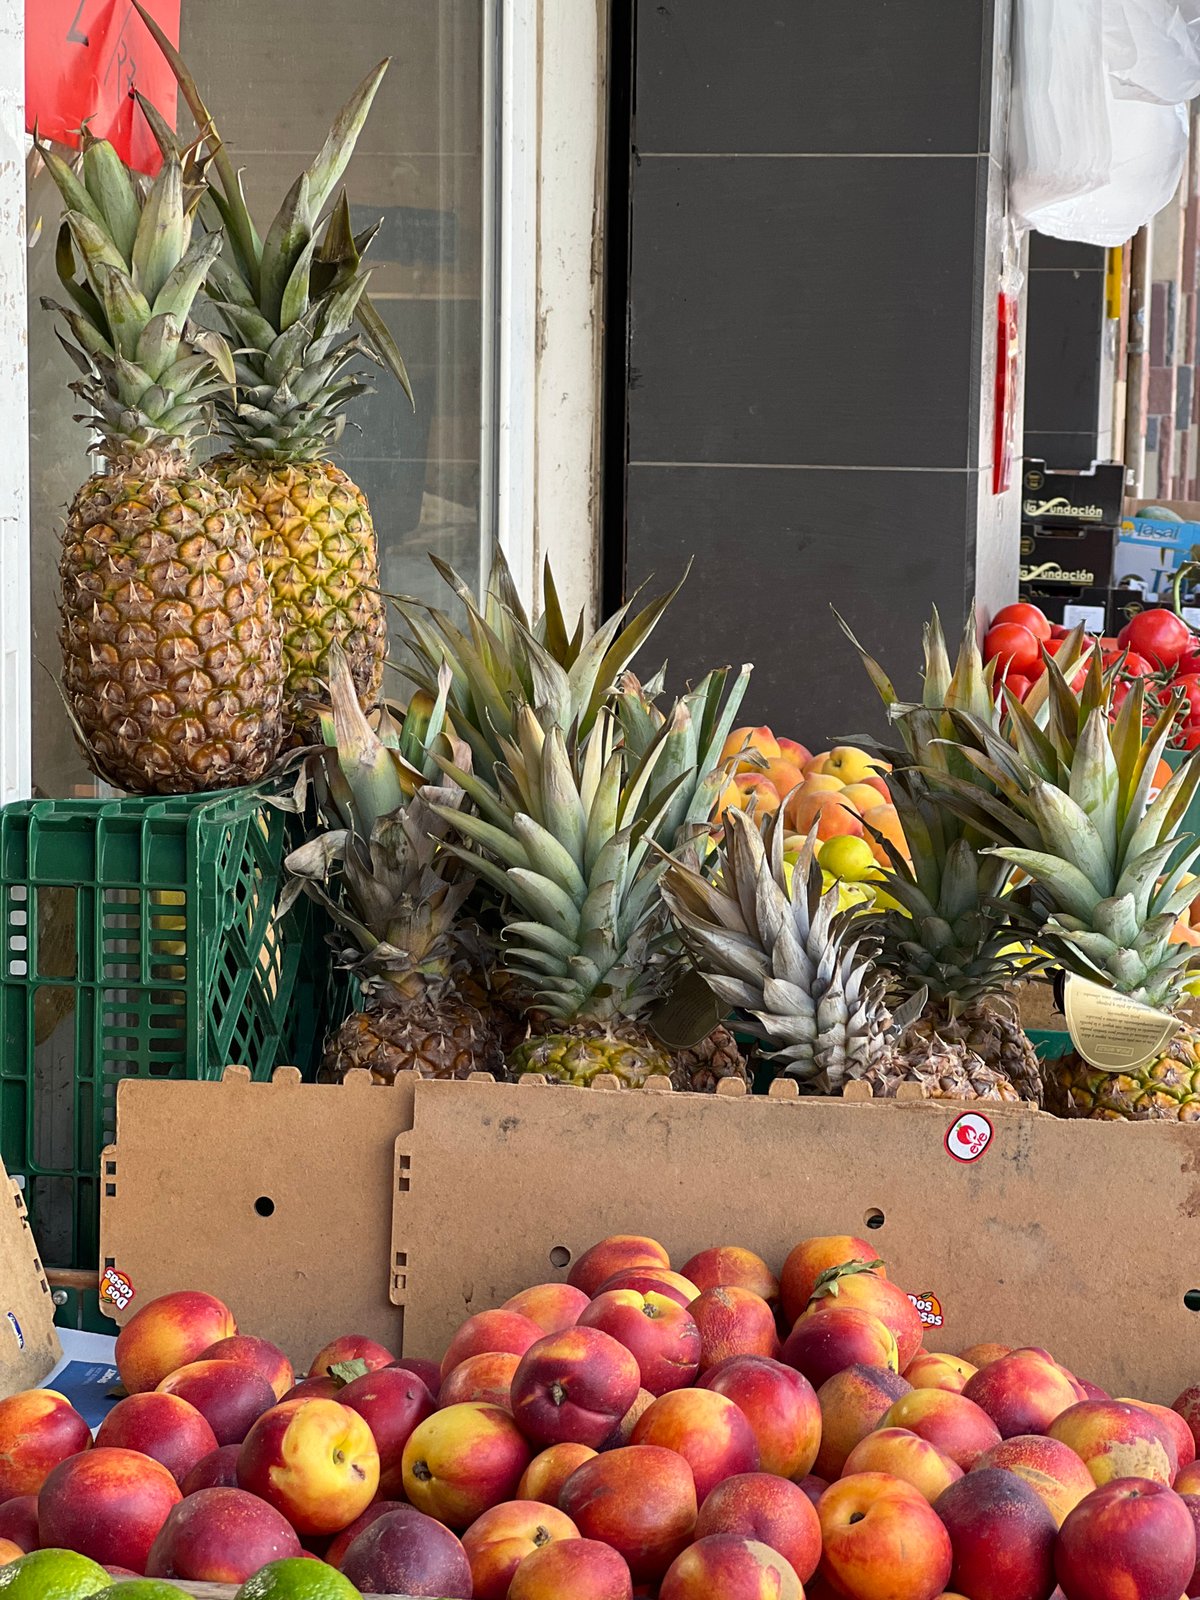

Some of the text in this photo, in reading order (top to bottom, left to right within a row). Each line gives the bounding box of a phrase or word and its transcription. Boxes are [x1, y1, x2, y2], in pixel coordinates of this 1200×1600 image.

[969, 1132, 988, 1154] eve
[104, 1269, 133, 1298] cosas
[105, 1285, 129, 1310] Dos
[918, 1310, 943, 1326] sas
